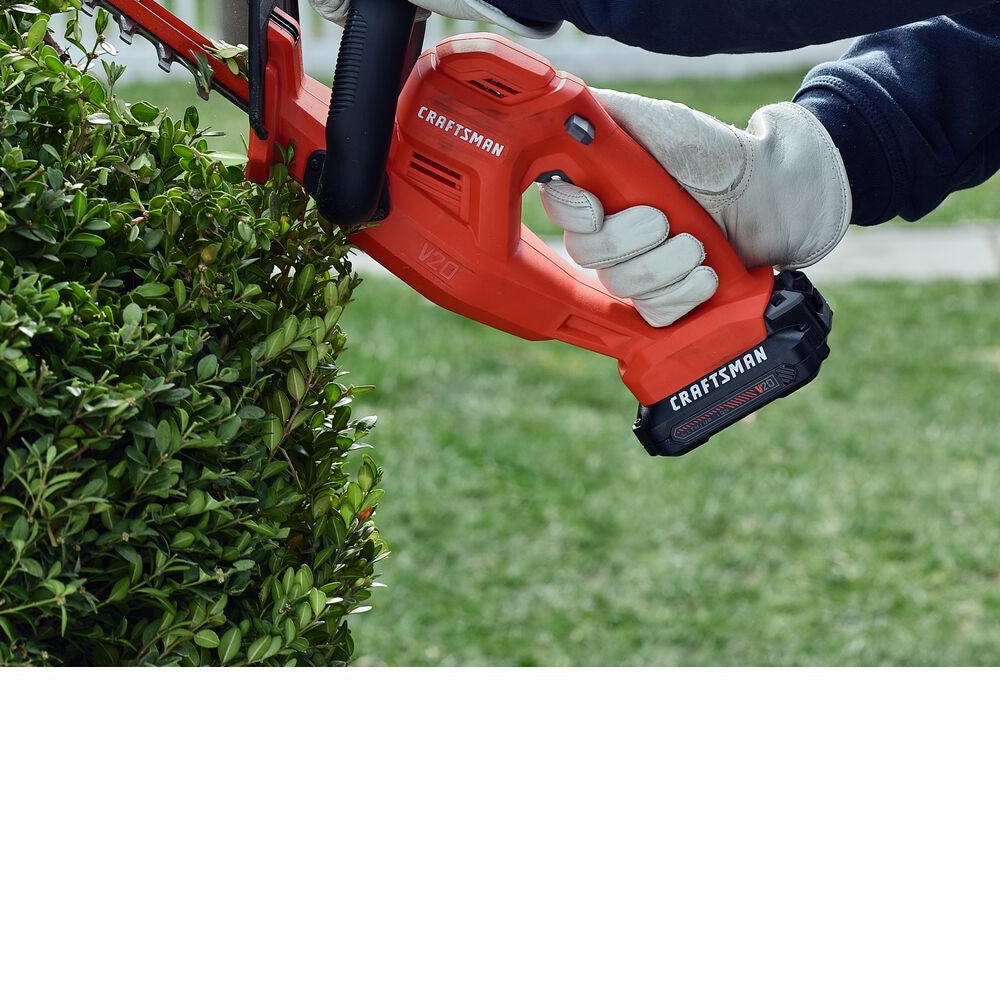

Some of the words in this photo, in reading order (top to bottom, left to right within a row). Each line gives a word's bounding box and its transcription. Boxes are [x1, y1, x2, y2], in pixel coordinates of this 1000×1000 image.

[417, 106, 504, 157] CRAFTSMAN
[418, 242, 459, 280] V20
[669, 346, 768, 411] CRAFTSMAN
[755, 379, 774, 393] V20
